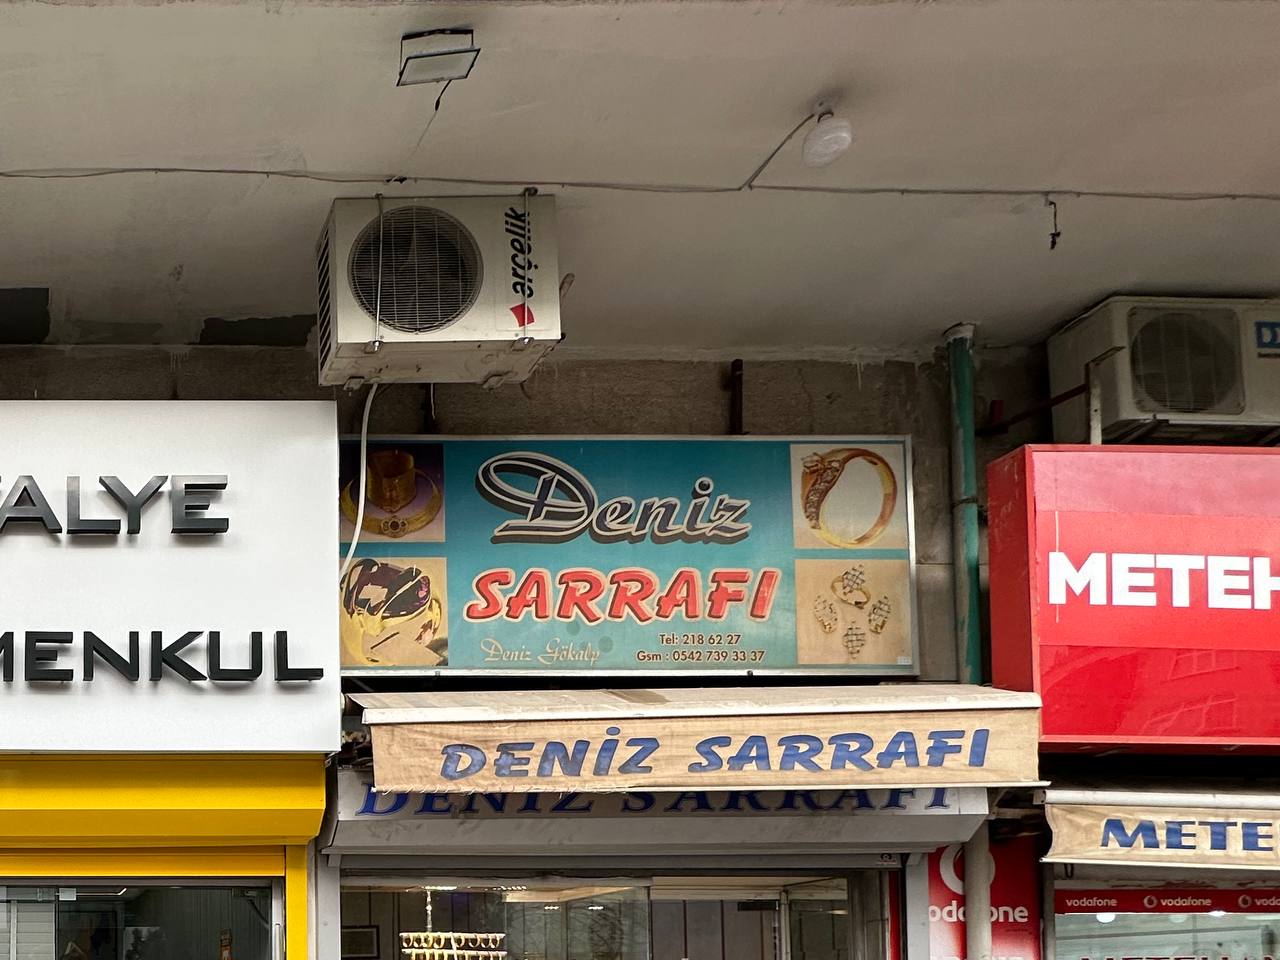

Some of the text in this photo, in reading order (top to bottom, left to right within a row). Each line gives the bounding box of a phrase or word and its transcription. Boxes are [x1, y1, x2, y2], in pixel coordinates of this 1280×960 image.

[504, 207, 539, 299] arçelik
[474, 449, 753, 545] Deniz
[464, 565, 782, 627] SARRAFI
[1048, 551, 1280, 611] METEH
[480, 637, 601, 667] Deniz Gökalp
[636, 649, 662, 663] Gsm
[672, 649, 704, 663] 0542
[706, 649, 730, 663] 739
[732, 649, 748, 663] 33
[750, 649, 766, 663] 37
[659, 633, 742, 646] Tel: 218 62 27
[439, 726, 992, 781] DENİZ SARRAFI
[1066, 896, 1118, 907] vodafone
[1160, 896, 1212, 907] vodafone
